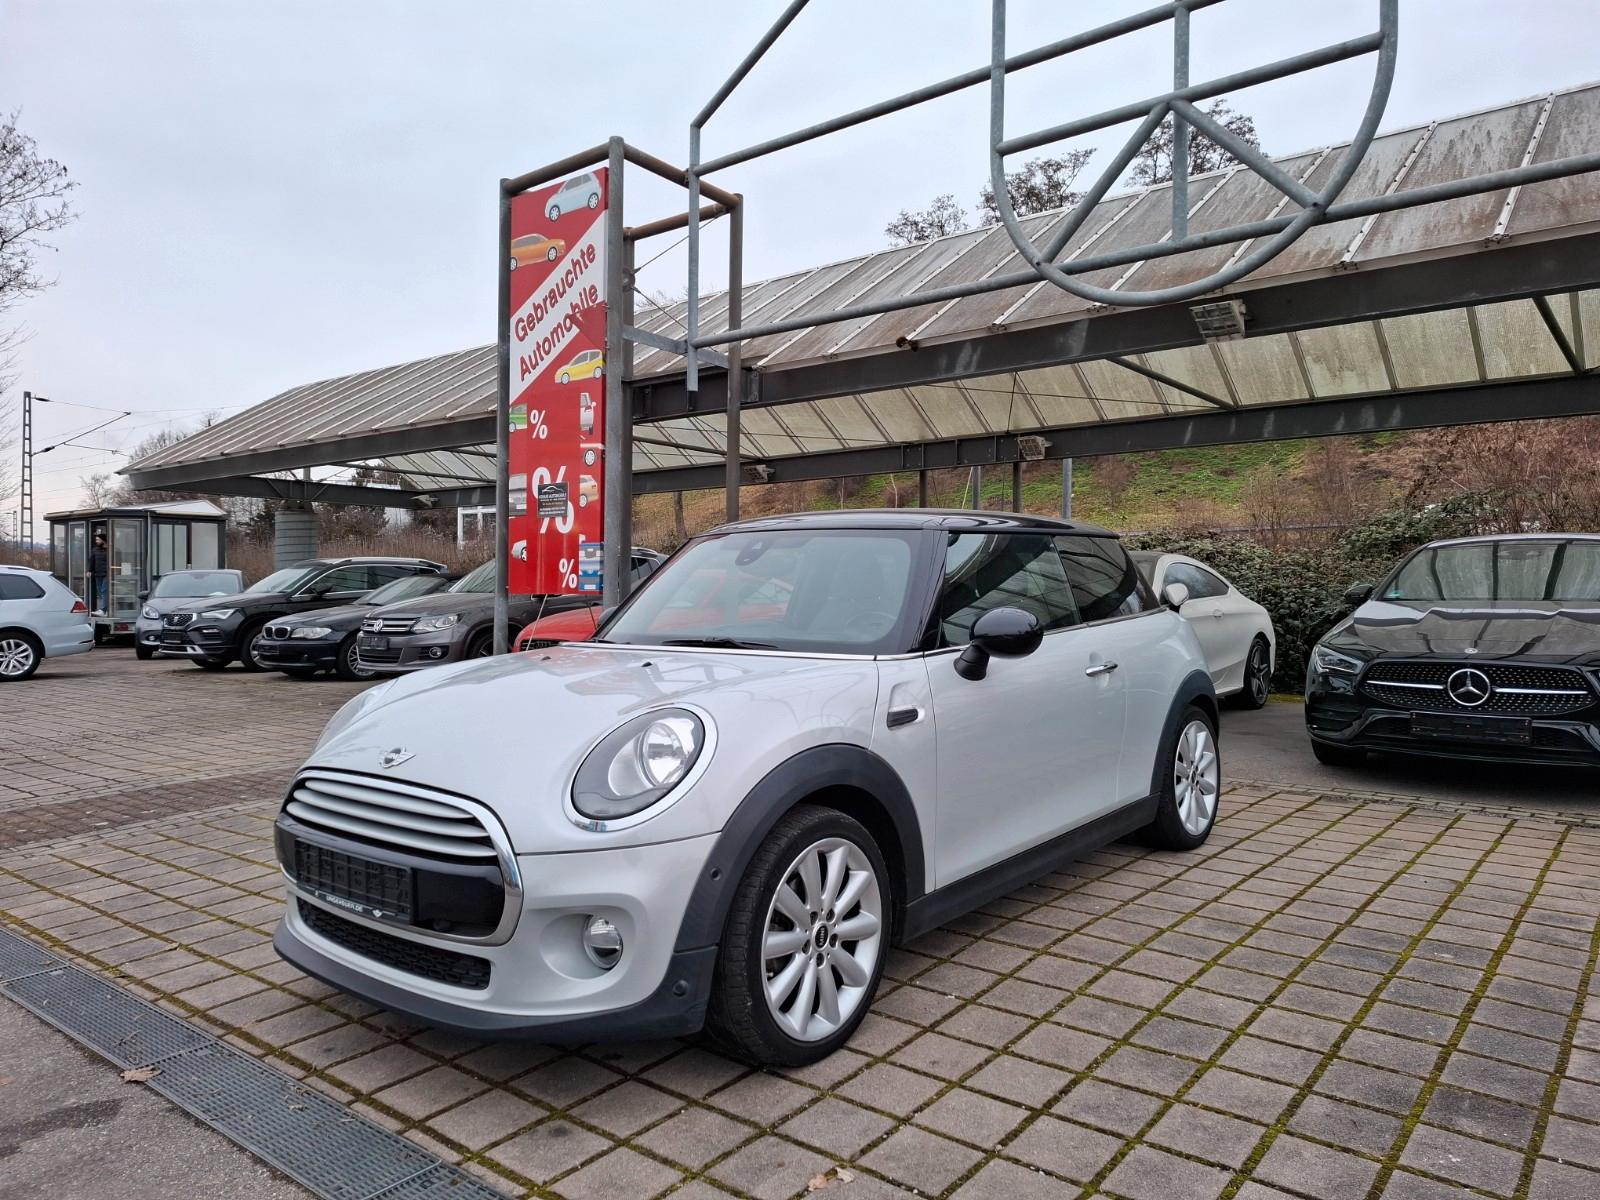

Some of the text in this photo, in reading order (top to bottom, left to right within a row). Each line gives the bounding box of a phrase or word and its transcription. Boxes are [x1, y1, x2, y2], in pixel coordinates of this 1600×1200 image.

[514, 243, 597, 342] Gebrauchte
[530, 409, 548, 440] %
[559, 558, 577, 589] %
